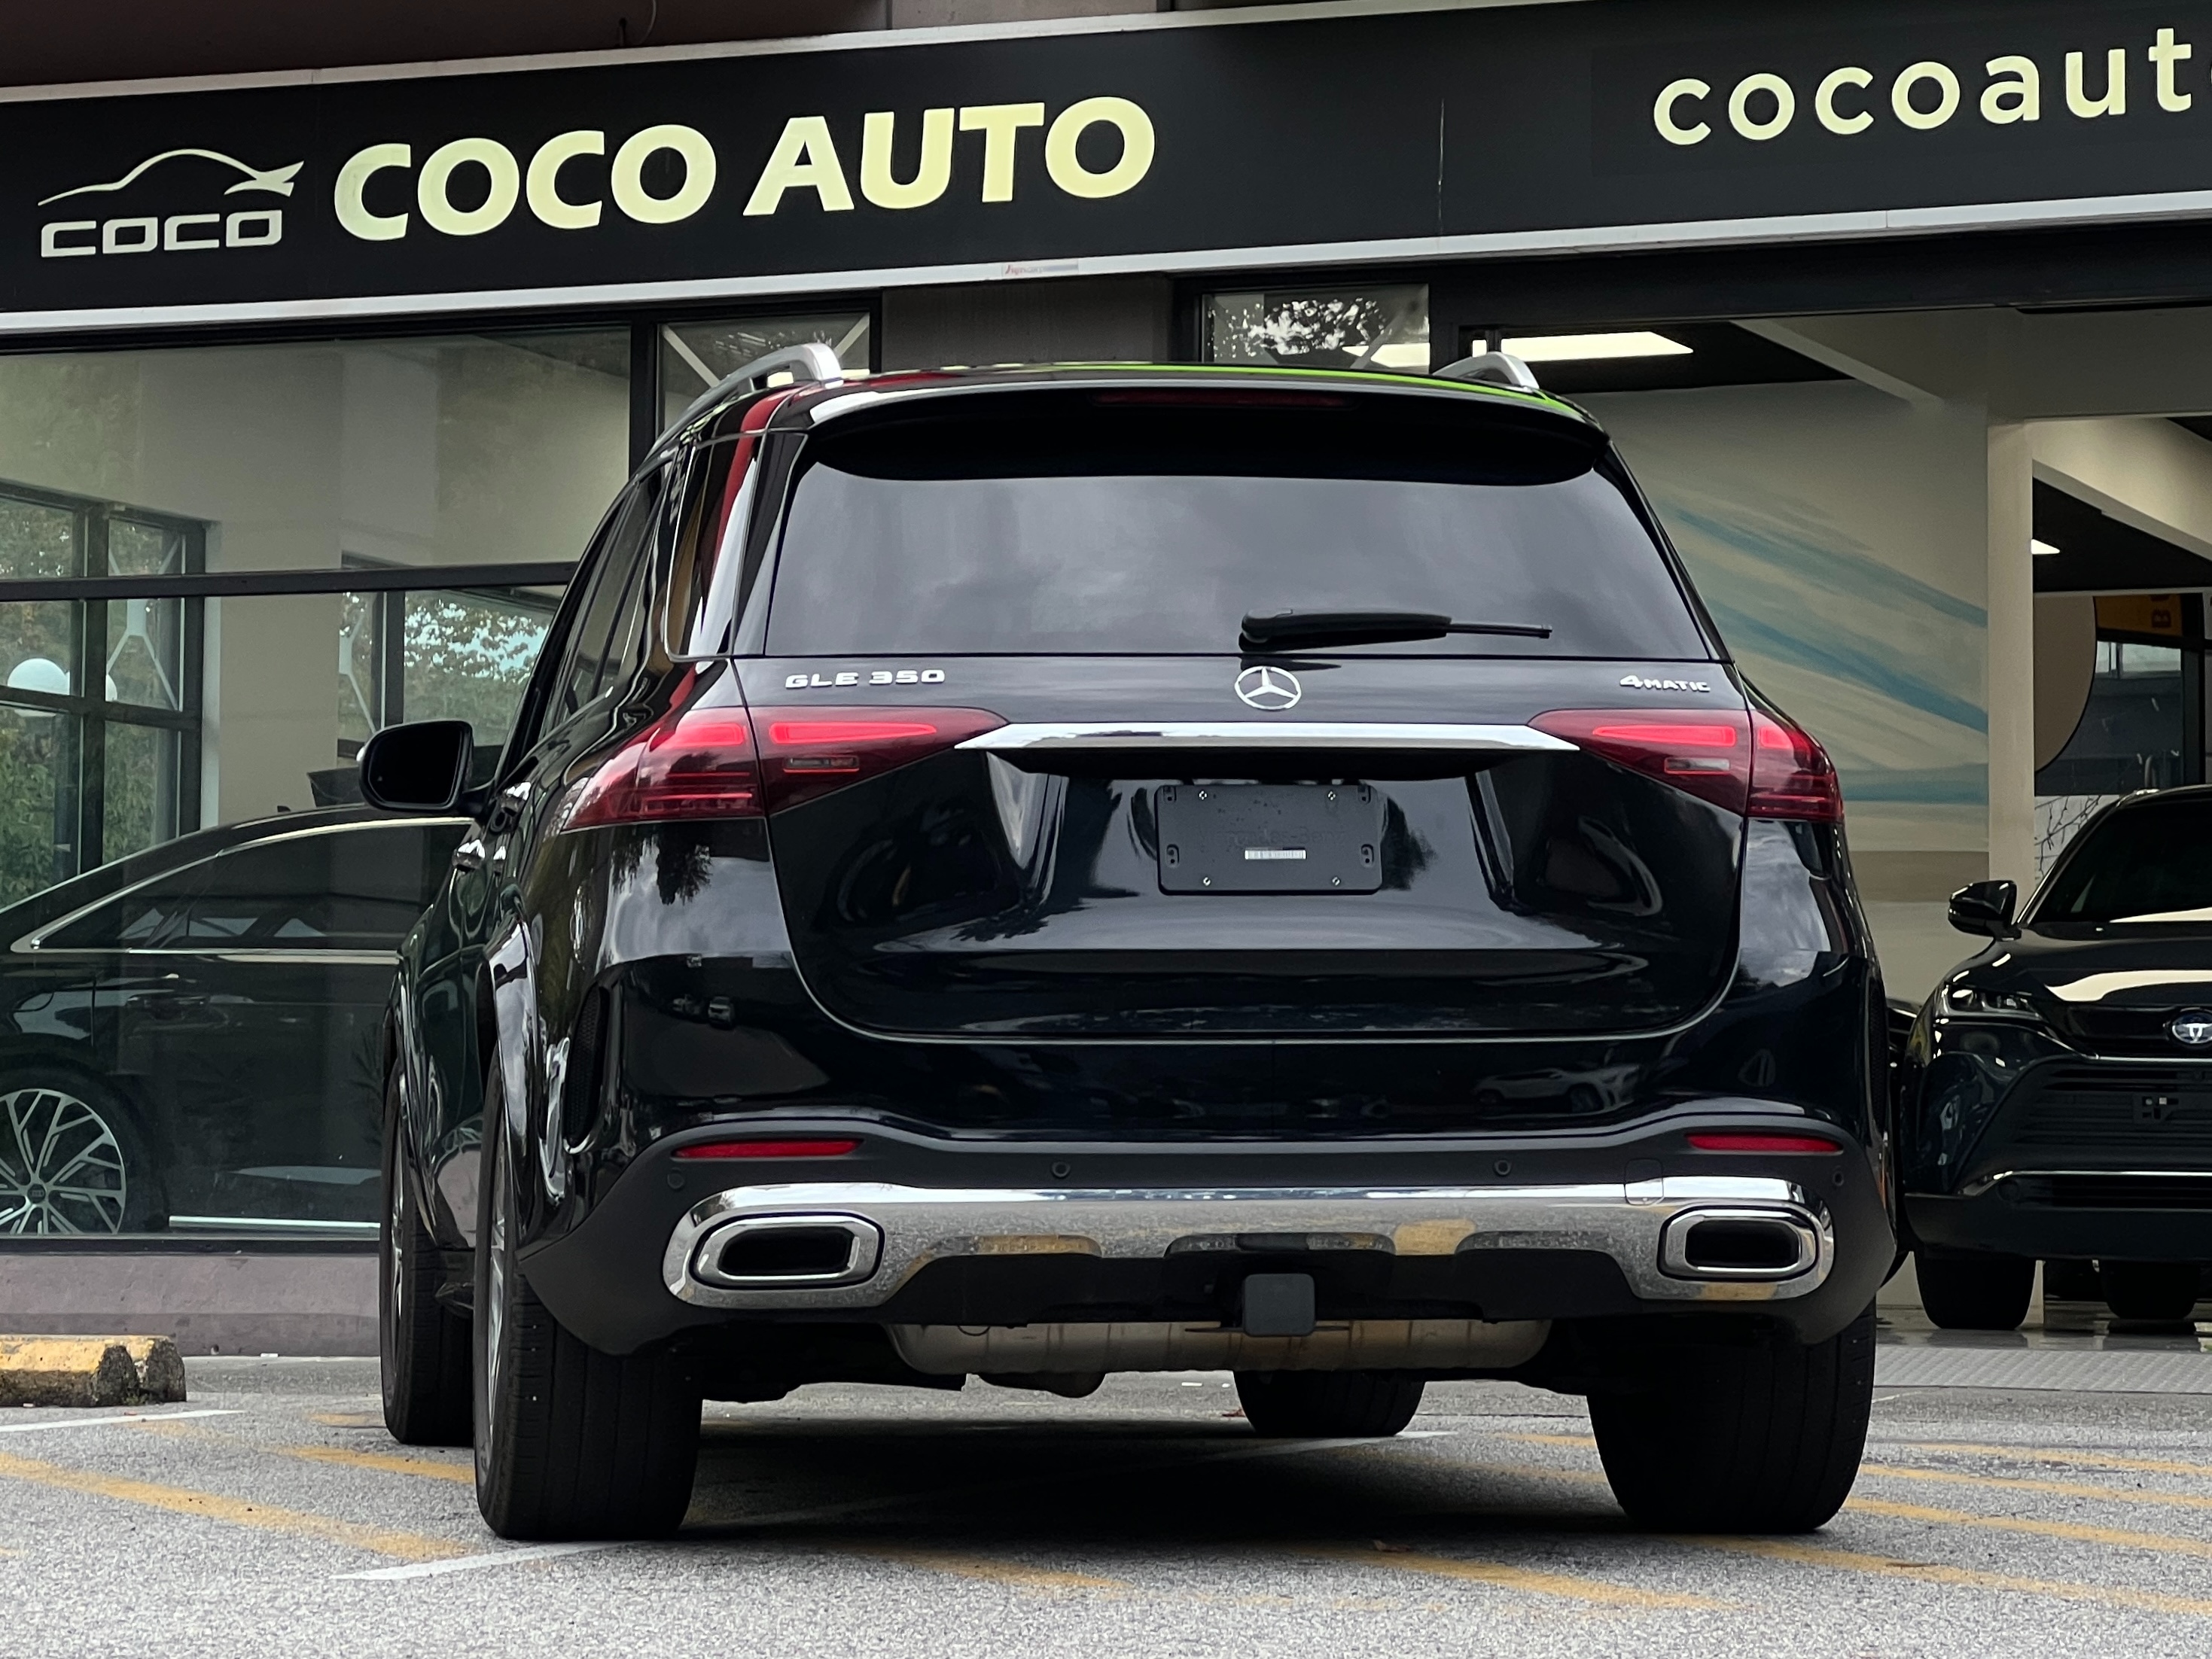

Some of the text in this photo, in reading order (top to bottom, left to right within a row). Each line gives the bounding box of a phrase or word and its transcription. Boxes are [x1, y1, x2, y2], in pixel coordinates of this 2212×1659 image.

[1654, 28, 2212, 145] cocoaut
[334, 97, 1155, 240] COCO AUTO
[41, 210, 282, 257] COCO
[785, 669, 945, 689] GLE 350
[1619, 674, 1711, 692] 4MATIC
